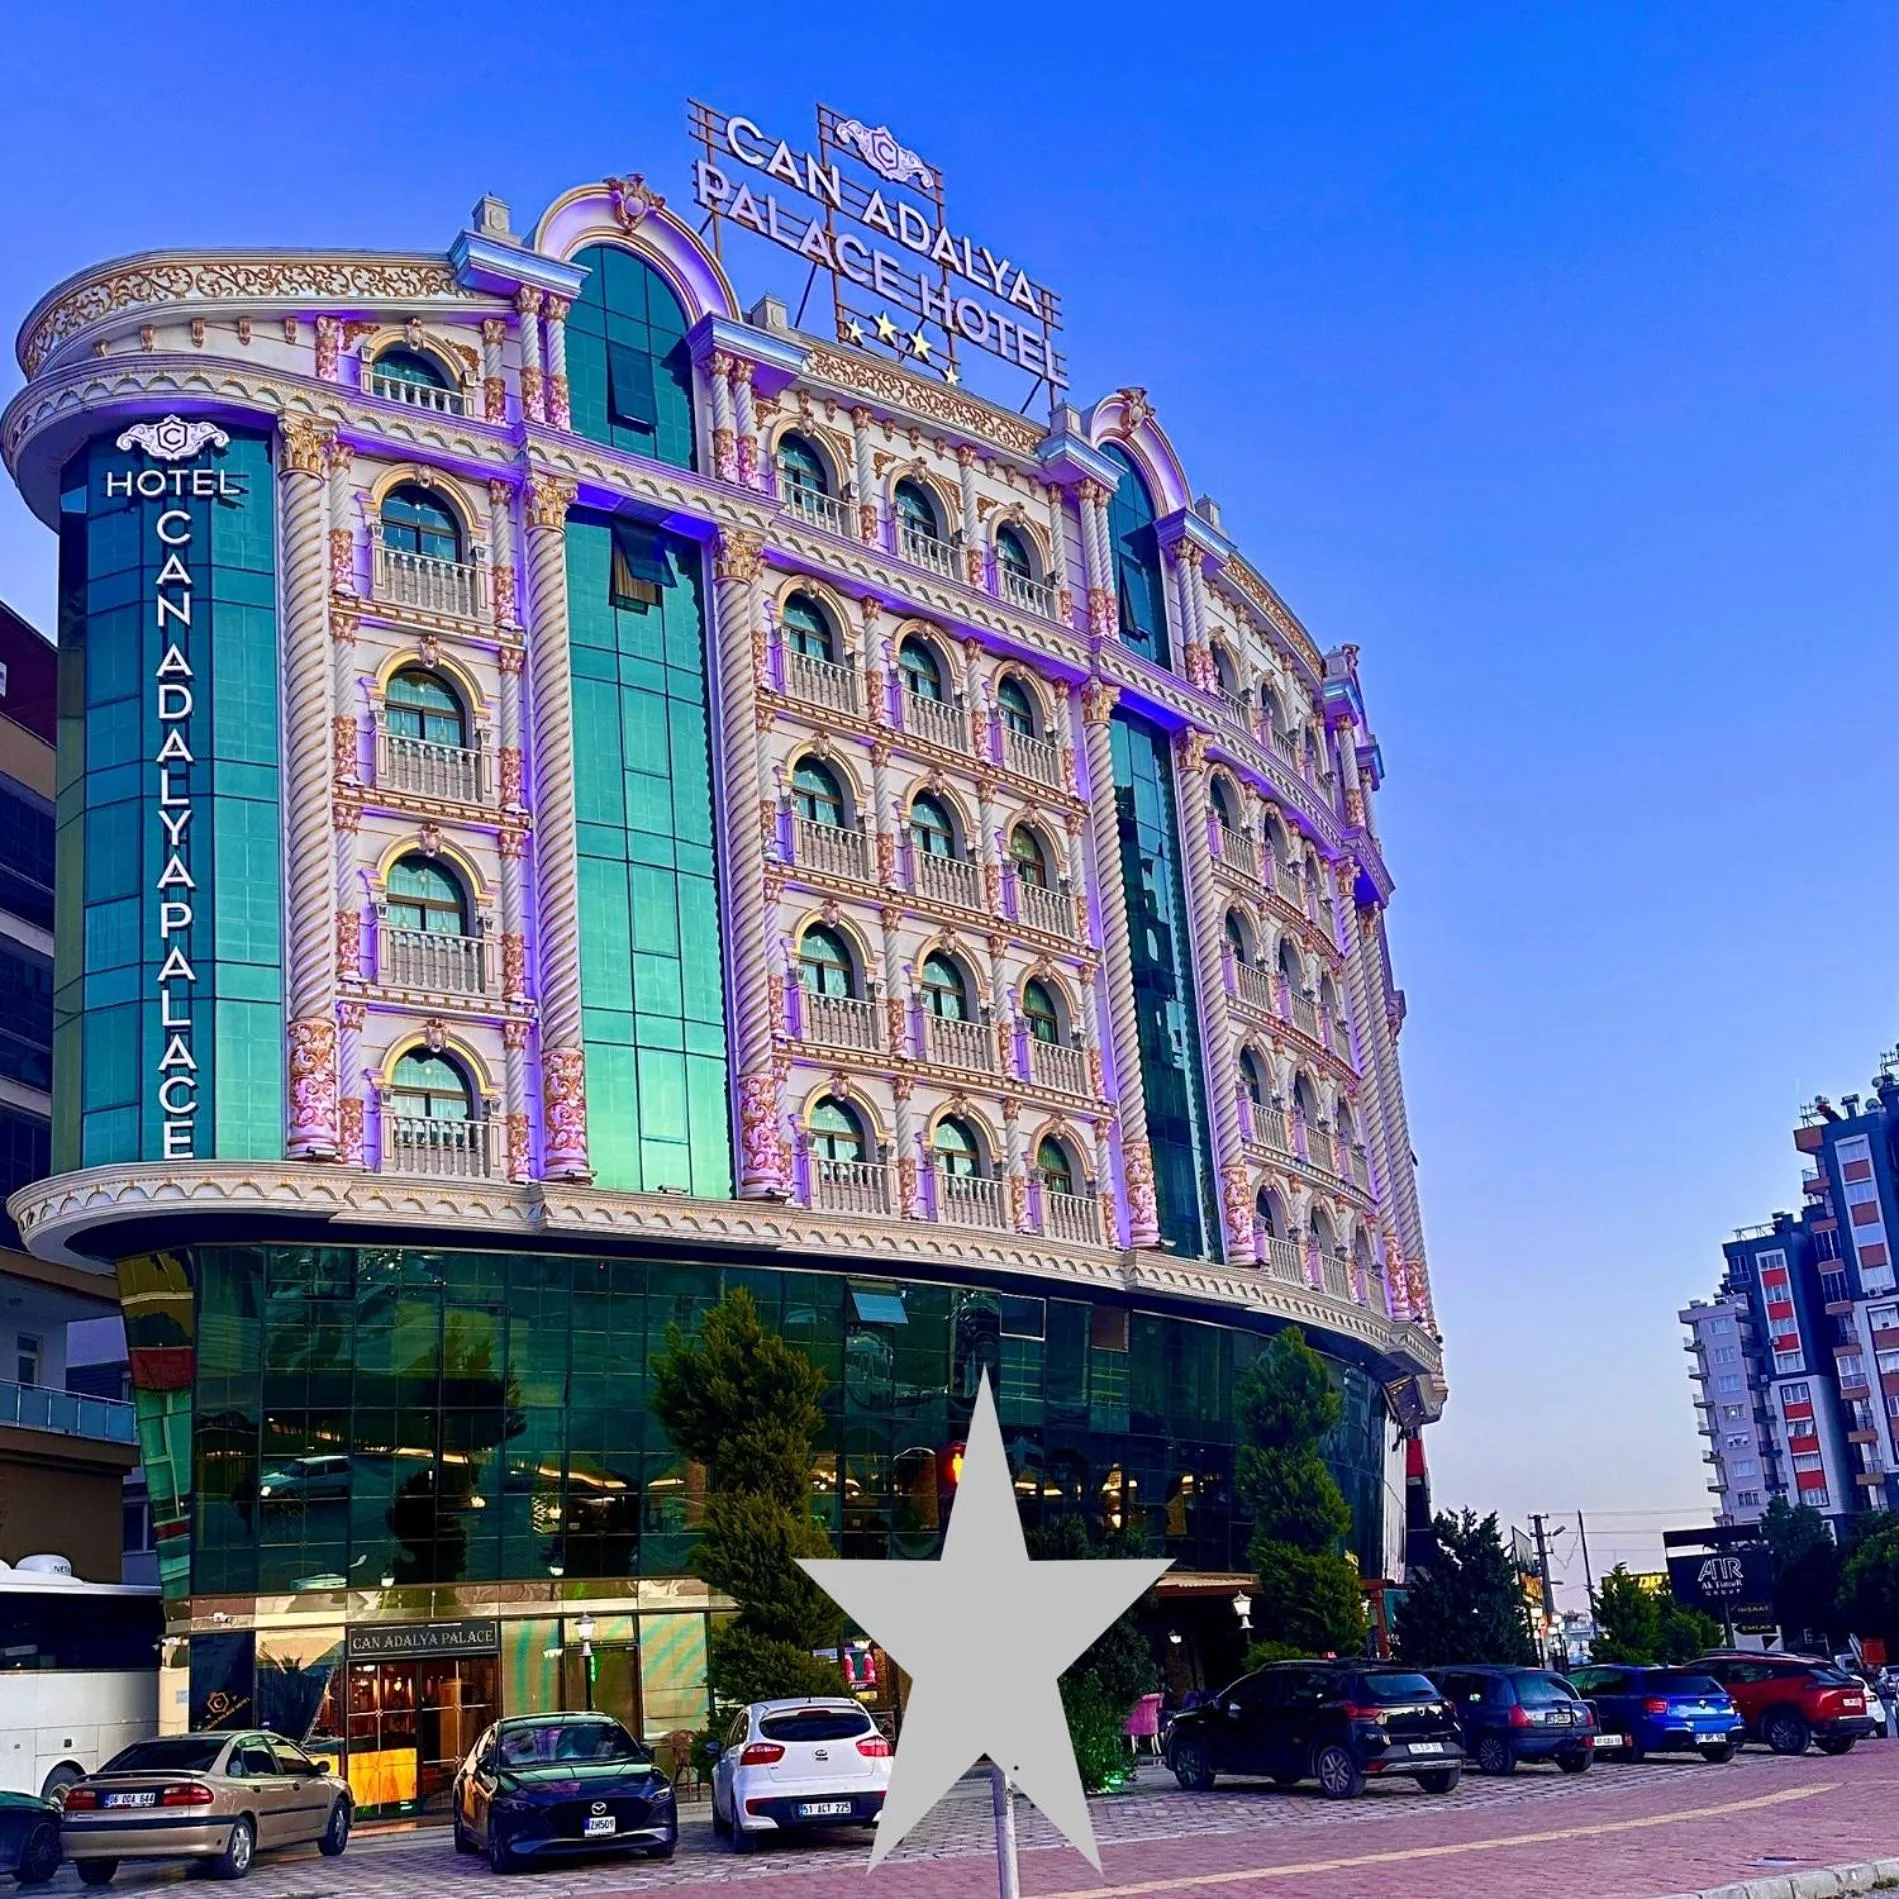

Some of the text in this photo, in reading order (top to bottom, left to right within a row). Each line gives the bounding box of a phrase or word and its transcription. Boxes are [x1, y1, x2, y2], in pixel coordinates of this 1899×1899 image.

[698, 160, 1071, 391] PALACE HOTEL
[726, 115, 1040, 316] CAN ADALYA
[107, 469, 240, 497] HOTEL
[155, 509, 198, 1160] CAN ADALYA PALACE
[352, 1629, 493, 1650] CAN ADALYA PALACE
